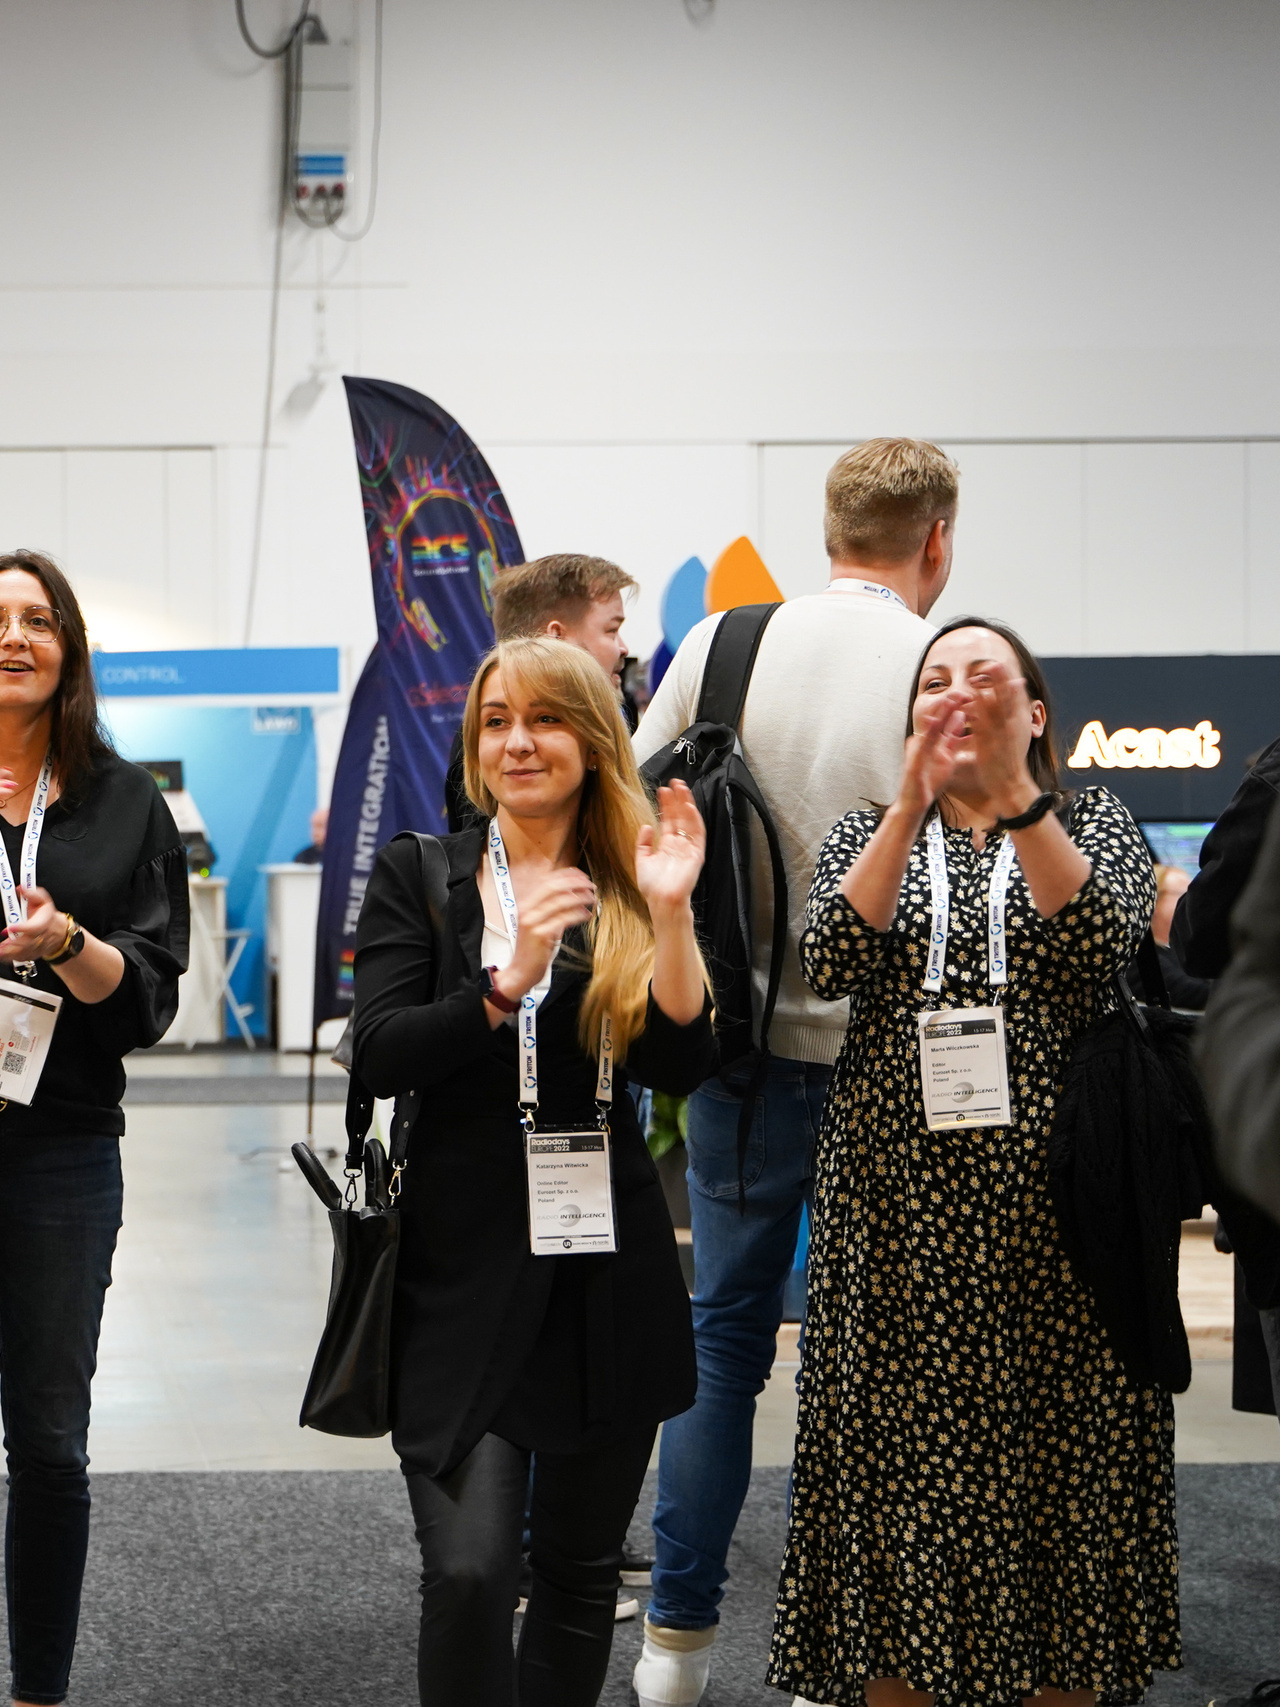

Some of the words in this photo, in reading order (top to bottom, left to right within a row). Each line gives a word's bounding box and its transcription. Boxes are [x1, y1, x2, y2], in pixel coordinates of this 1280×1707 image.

[501, 881, 509, 897] TRITON
[926, 1024, 962, 1032] Radiodays
[531, 1138, 570, 1146] Radiodays
